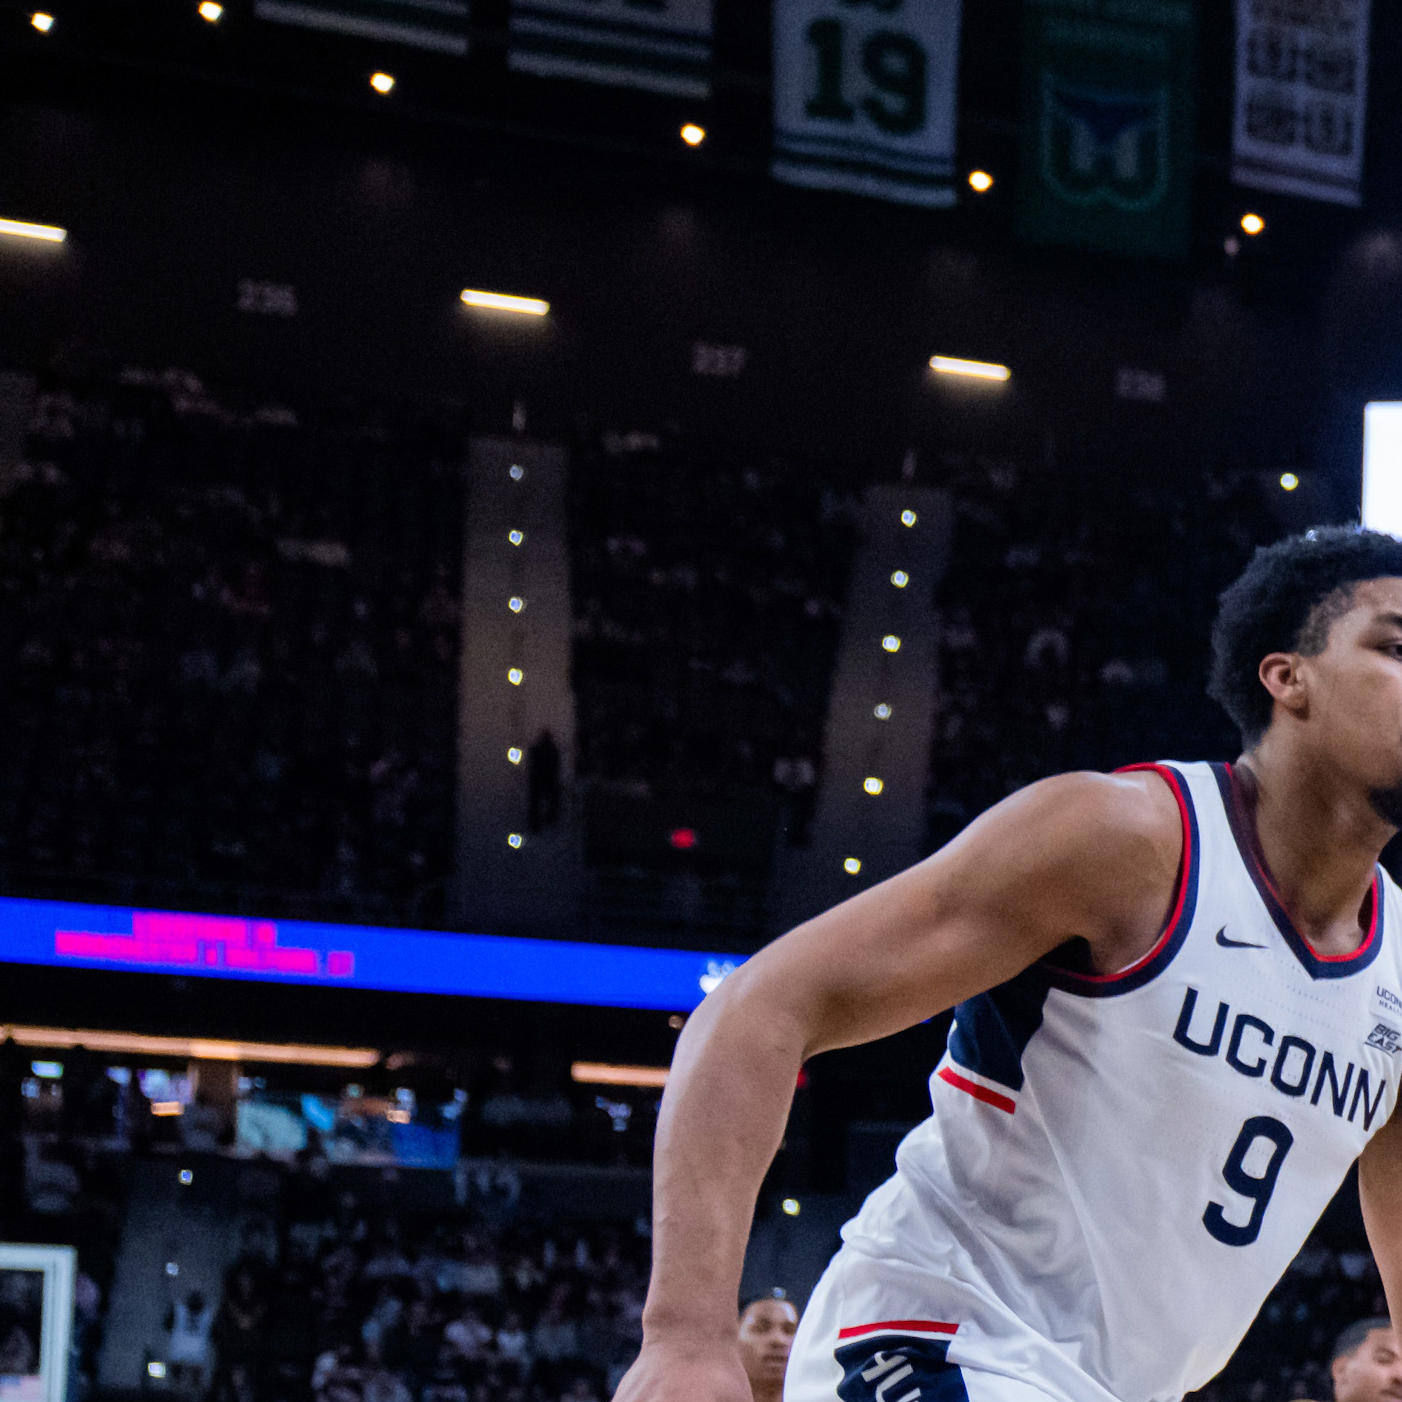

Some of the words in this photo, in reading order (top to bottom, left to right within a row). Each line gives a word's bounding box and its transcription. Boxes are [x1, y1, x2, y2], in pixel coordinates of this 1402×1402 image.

[804, 17, 927, 137] 19
[1173, 986, 1386, 1132] UCONN
[1367, 1031, 1402, 1054] EAST
[1374, 1023, 1402, 1041] BIG
[1202, 1115, 1294, 1247] 9
